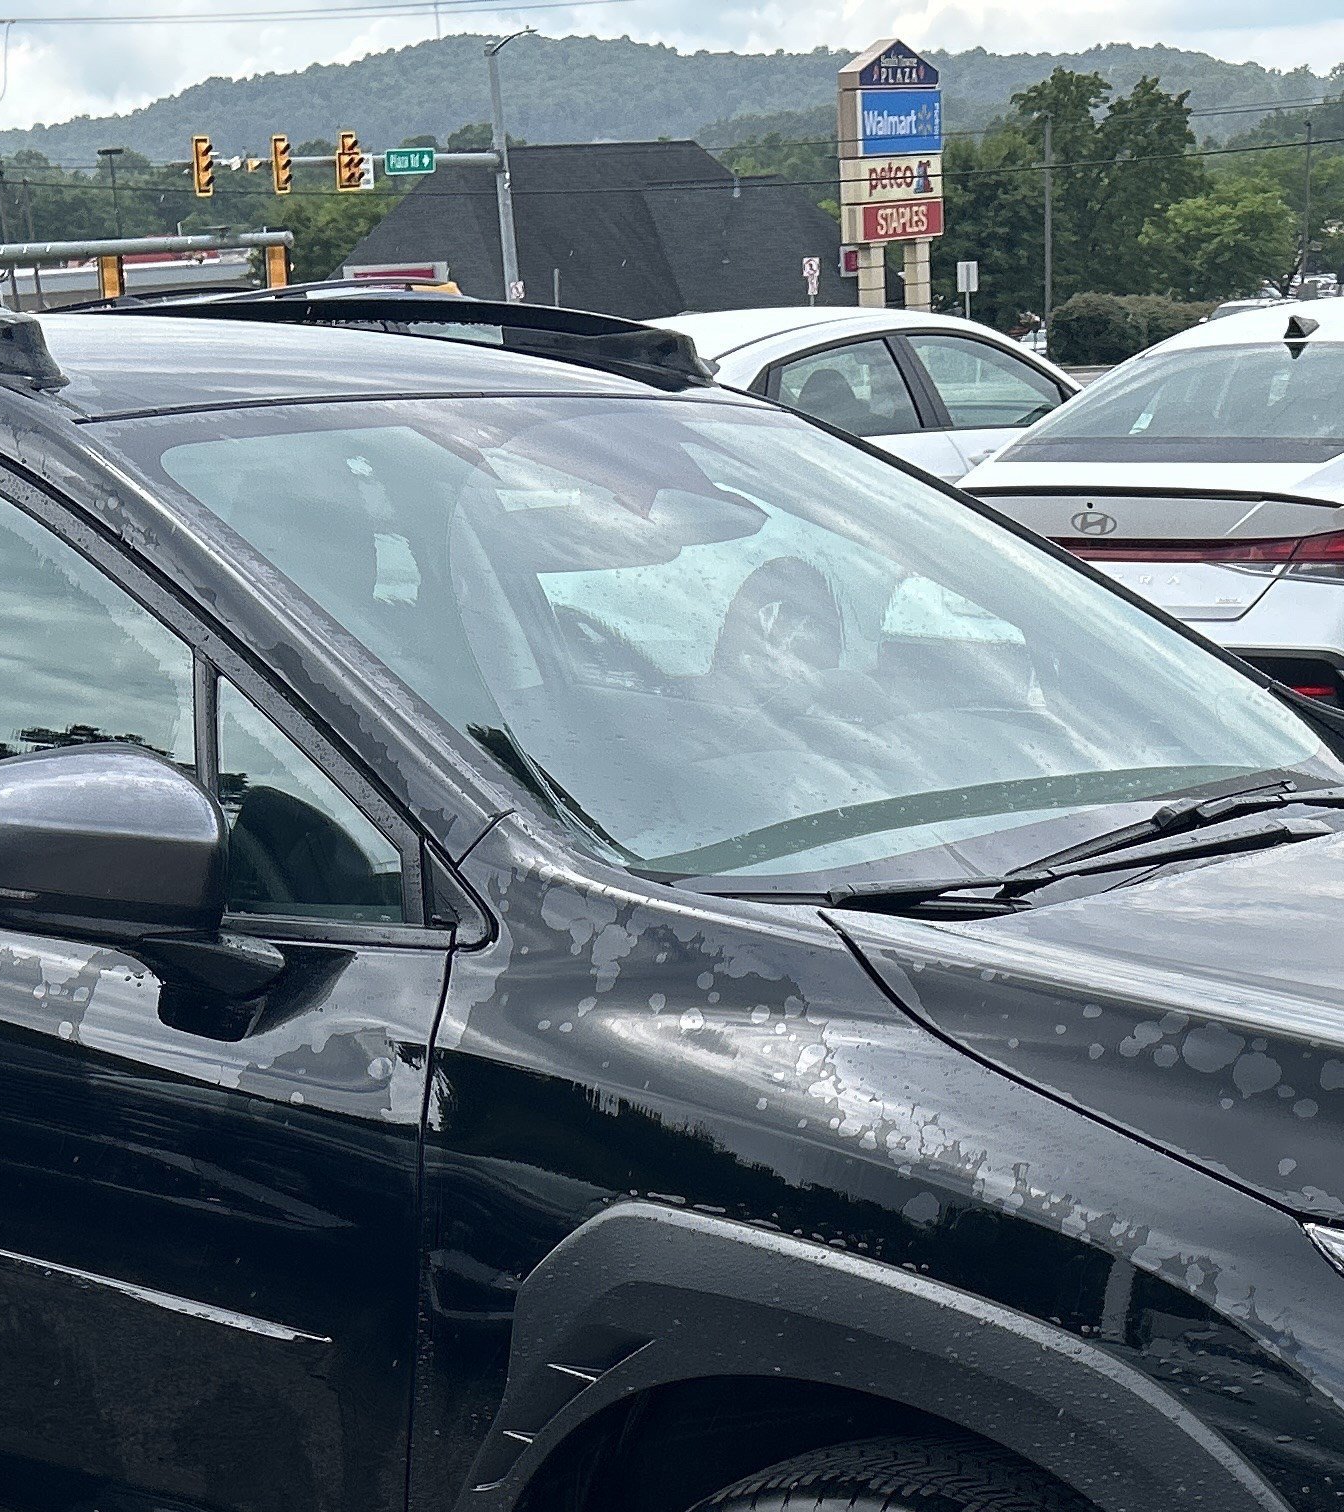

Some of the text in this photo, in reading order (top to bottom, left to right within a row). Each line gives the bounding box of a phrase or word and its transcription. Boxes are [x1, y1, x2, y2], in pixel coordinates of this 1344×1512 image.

[880, 67, 918, 83] PLAZA
[863, 109, 917, 136] Walmart
[868, 161, 914, 197] petco
[877, 205, 928, 235] STAPLES
